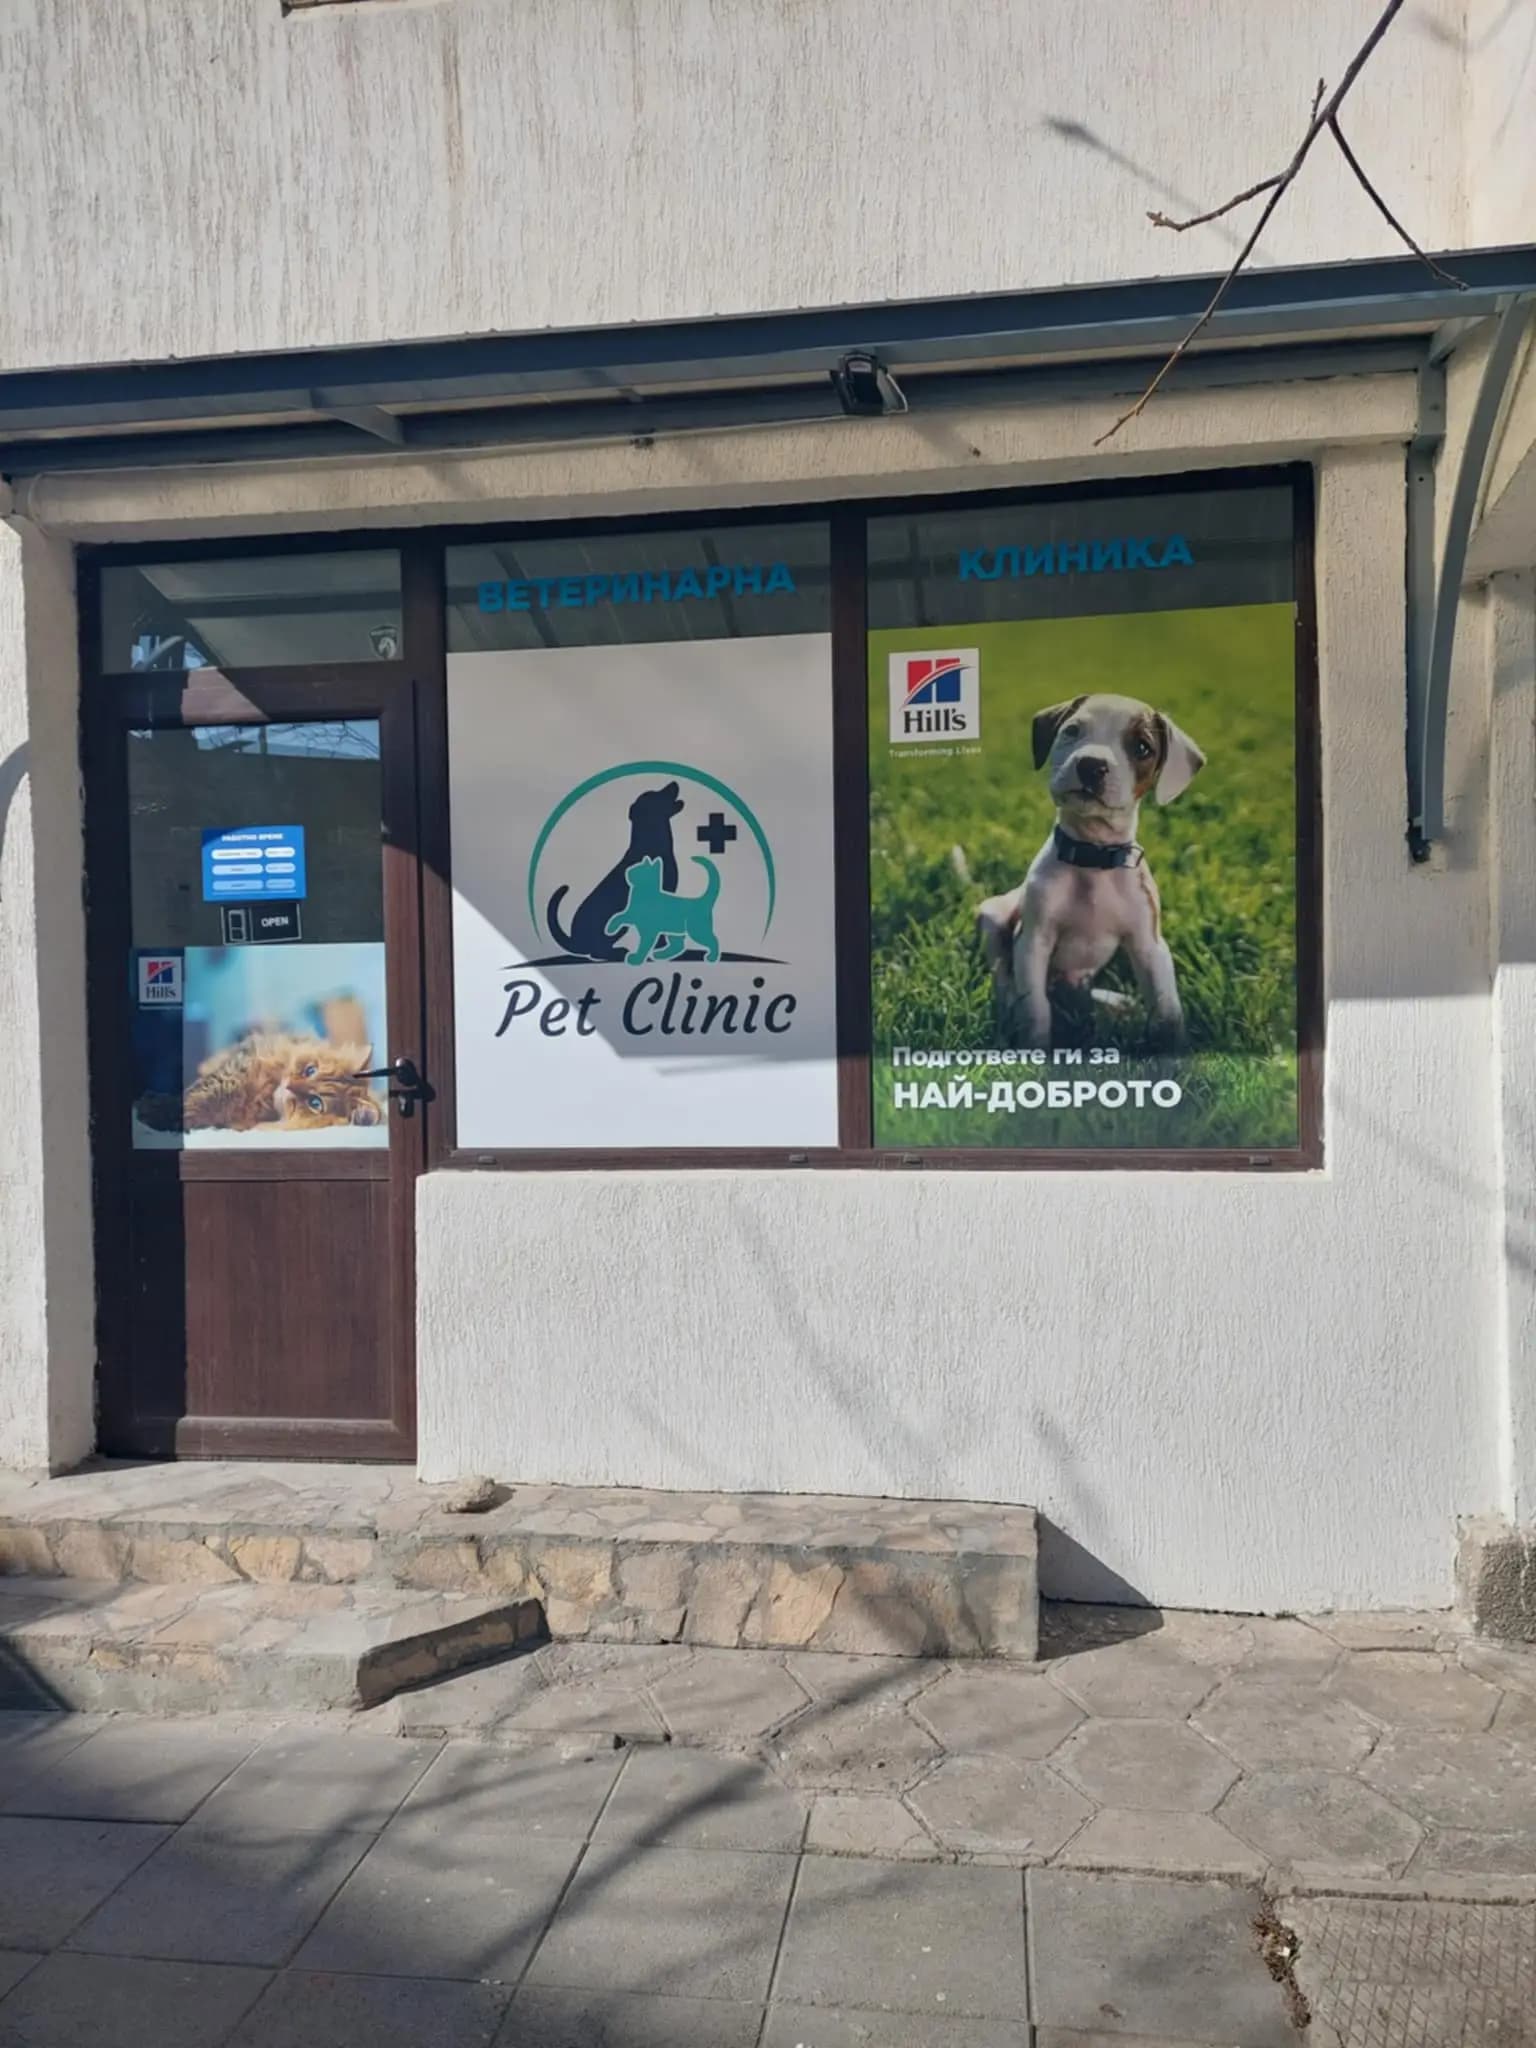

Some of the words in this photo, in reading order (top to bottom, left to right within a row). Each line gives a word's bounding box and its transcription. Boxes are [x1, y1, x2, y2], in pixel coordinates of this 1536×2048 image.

[958, 533, 1195, 581] КЛИНИКА
[476, 561, 796, 613] ВЕТЕРИНАРНА
[903, 708, 967, 734] Hill's
[261, 916, 289, 928] OPEN
[494, 980, 602, 1037] Pet
[622, 972, 797, 1036] Clinic
[892, 1046, 1047, 1069] Подгответе
[1053, 1048, 1082, 1065] ги
[1089, 1048, 1121, 1065] за
[893, 1074, 1182, 1113] НАЙ-ДОБРОТО
